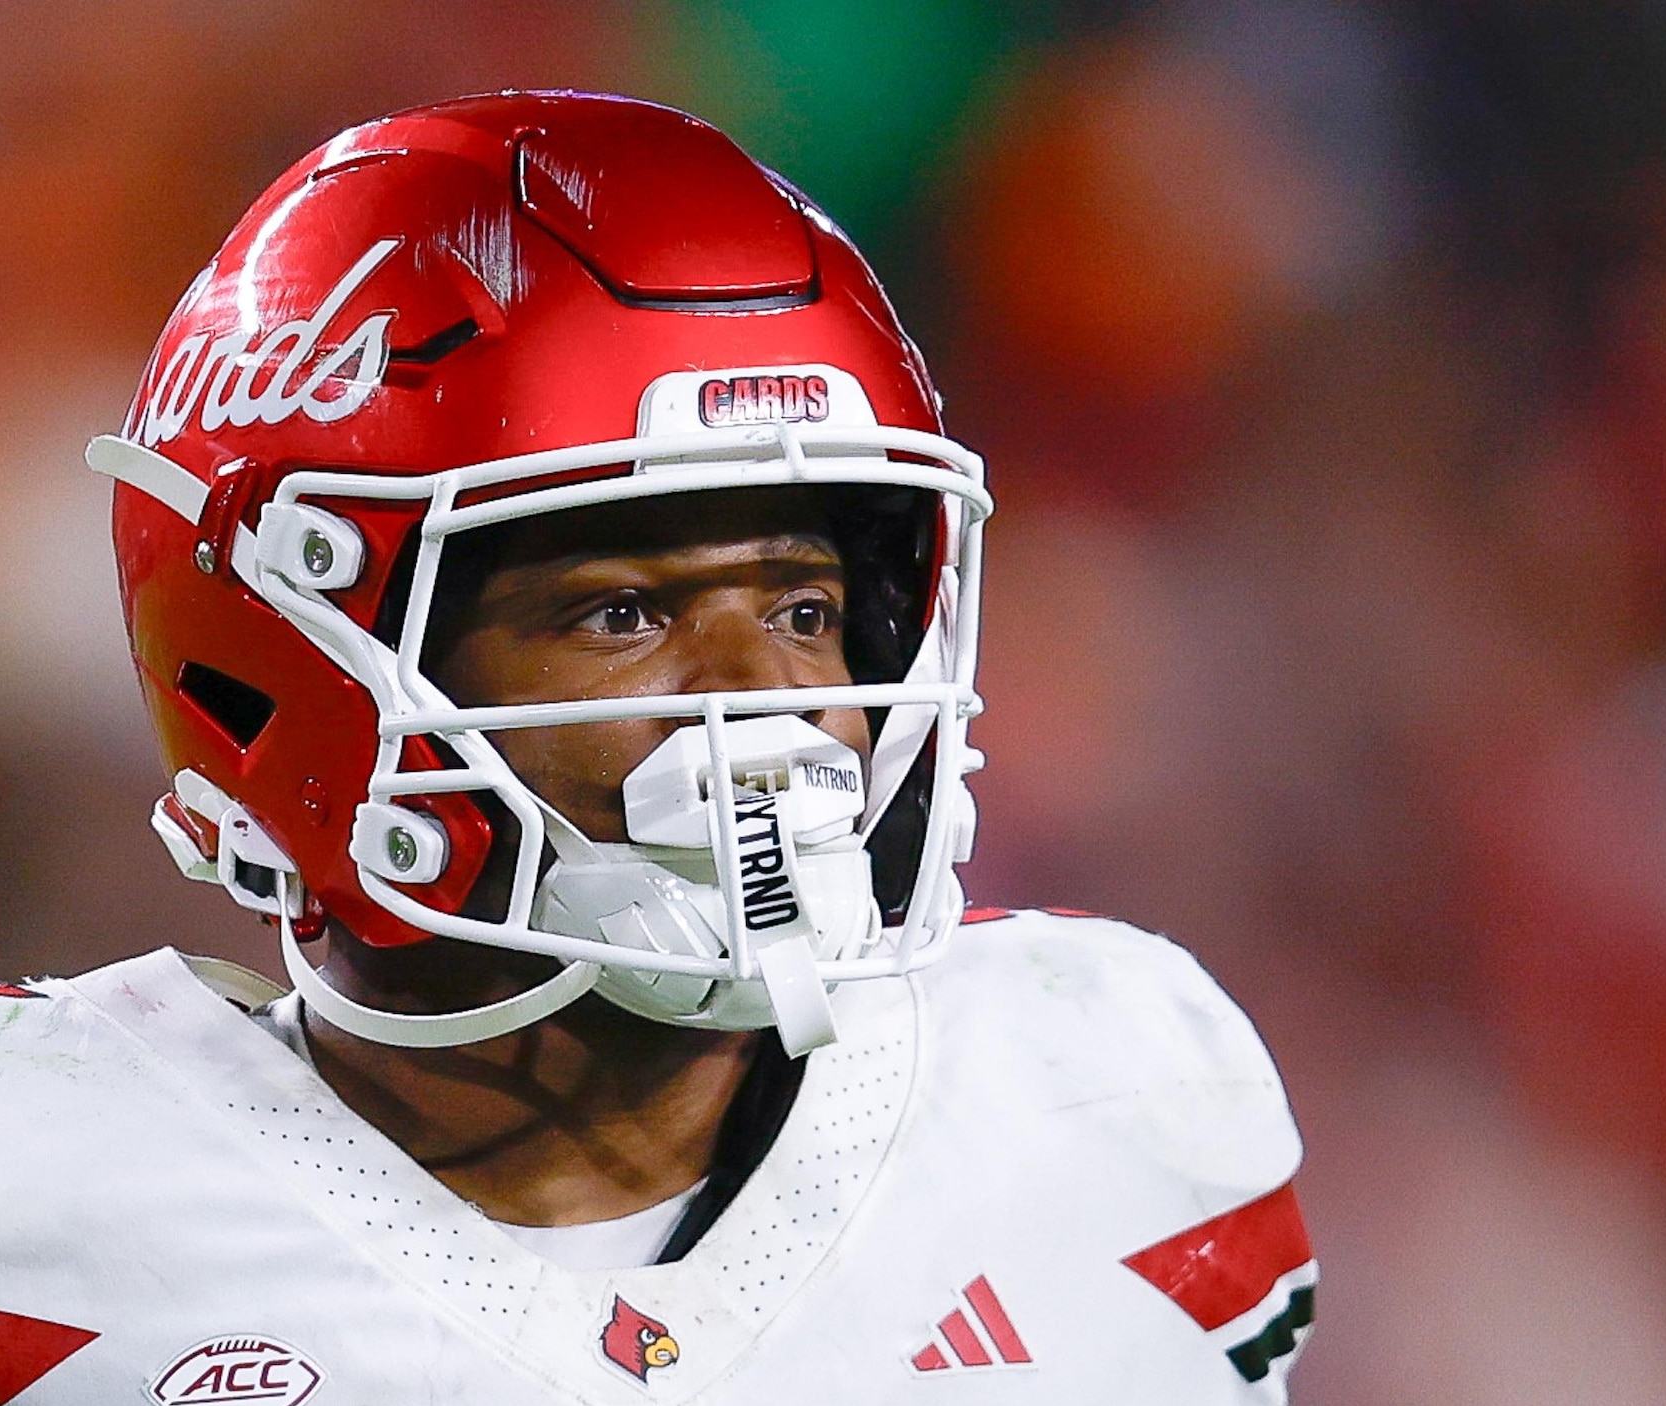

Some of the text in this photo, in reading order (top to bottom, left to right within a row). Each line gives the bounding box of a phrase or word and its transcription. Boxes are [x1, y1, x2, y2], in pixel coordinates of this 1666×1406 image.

[698, 375, 830, 428] CARDS
[803, 763, 858, 793] NXTRND
[180, 1358, 295, 1396] ACC
